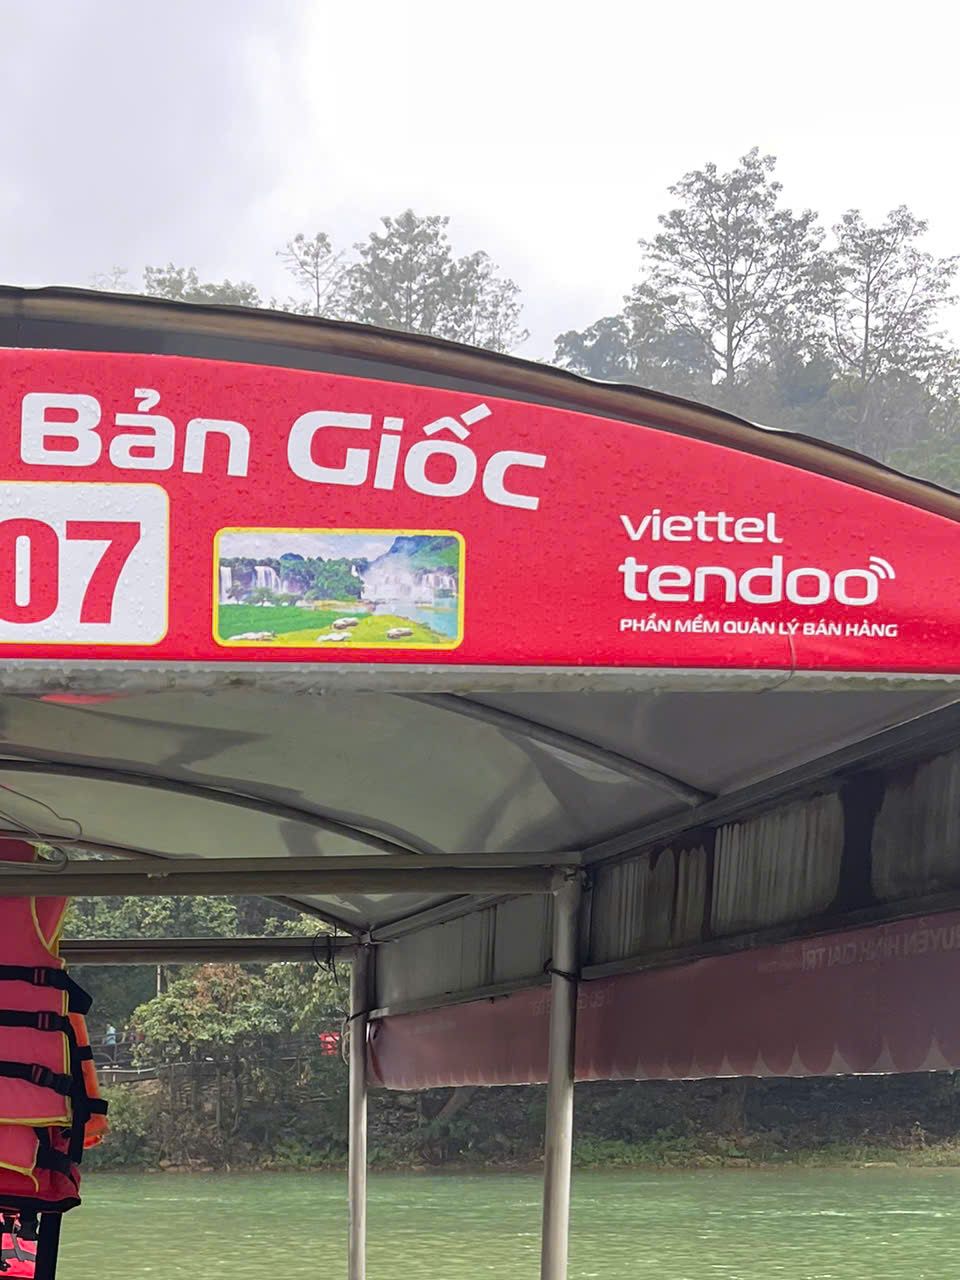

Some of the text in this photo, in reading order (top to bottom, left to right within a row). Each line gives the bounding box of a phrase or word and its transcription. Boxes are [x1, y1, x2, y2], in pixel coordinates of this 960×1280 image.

[20, 388, 251, 478] Bản
[287, 403, 546, 511] Giốc
[620, 509, 783, 543] viettel
[618, 555, 879, 606] tendoo
[724, 616, 776, 635] QUẢN
[779, 618, 799, 636] LÝ
[803, 619, 841, 636] BÁN
[846, 619, 898, 637] HÀNG
